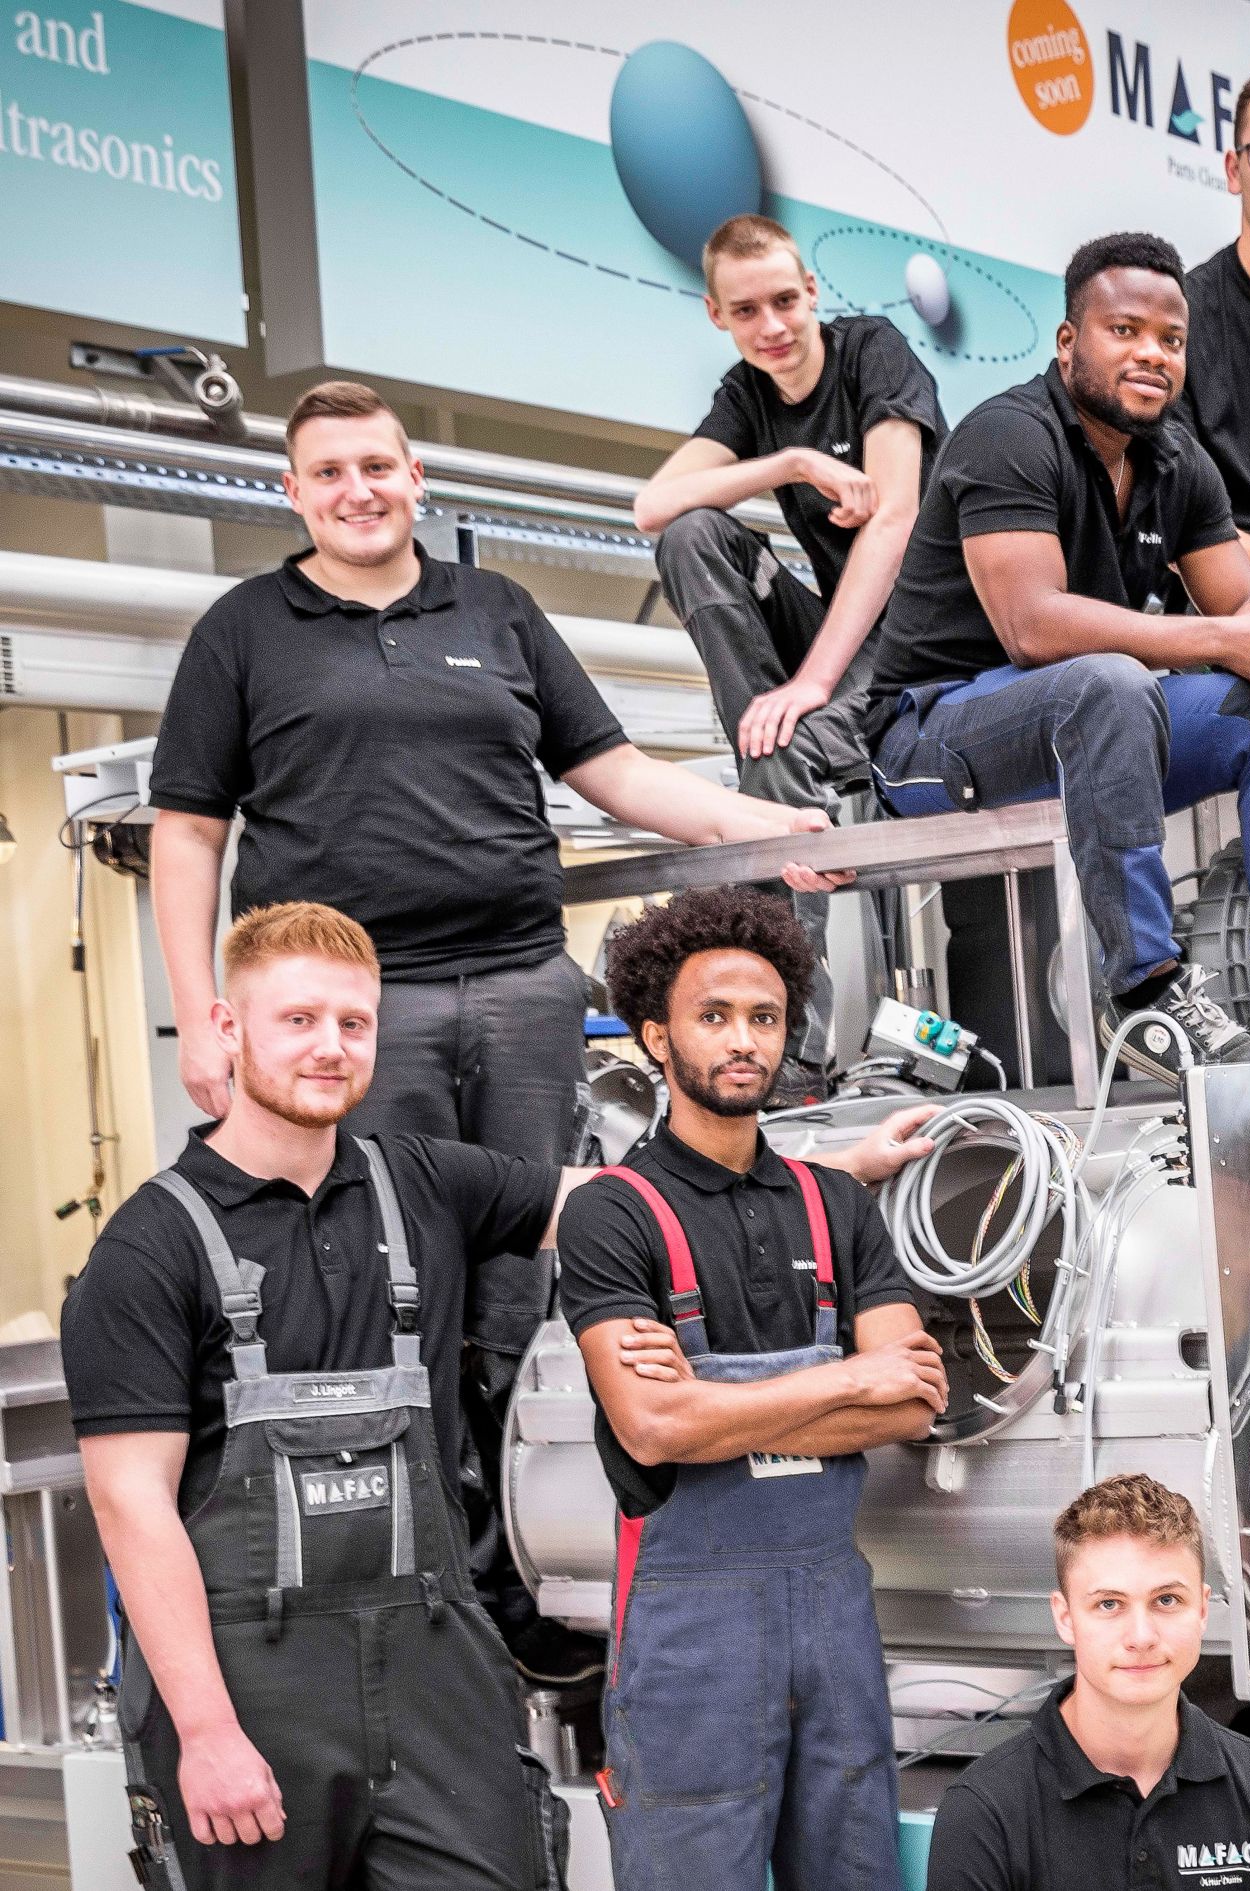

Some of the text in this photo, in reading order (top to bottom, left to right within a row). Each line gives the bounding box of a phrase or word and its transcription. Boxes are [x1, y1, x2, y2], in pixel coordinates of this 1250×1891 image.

[15, 11, 110, 75] and
[1012, 23, 1086, 69] coming
[1034, 73, 1081, 110] soon
[1106, 28, 1237, 153] MAF
[306, 1475, 385, 1506] MAFAC
